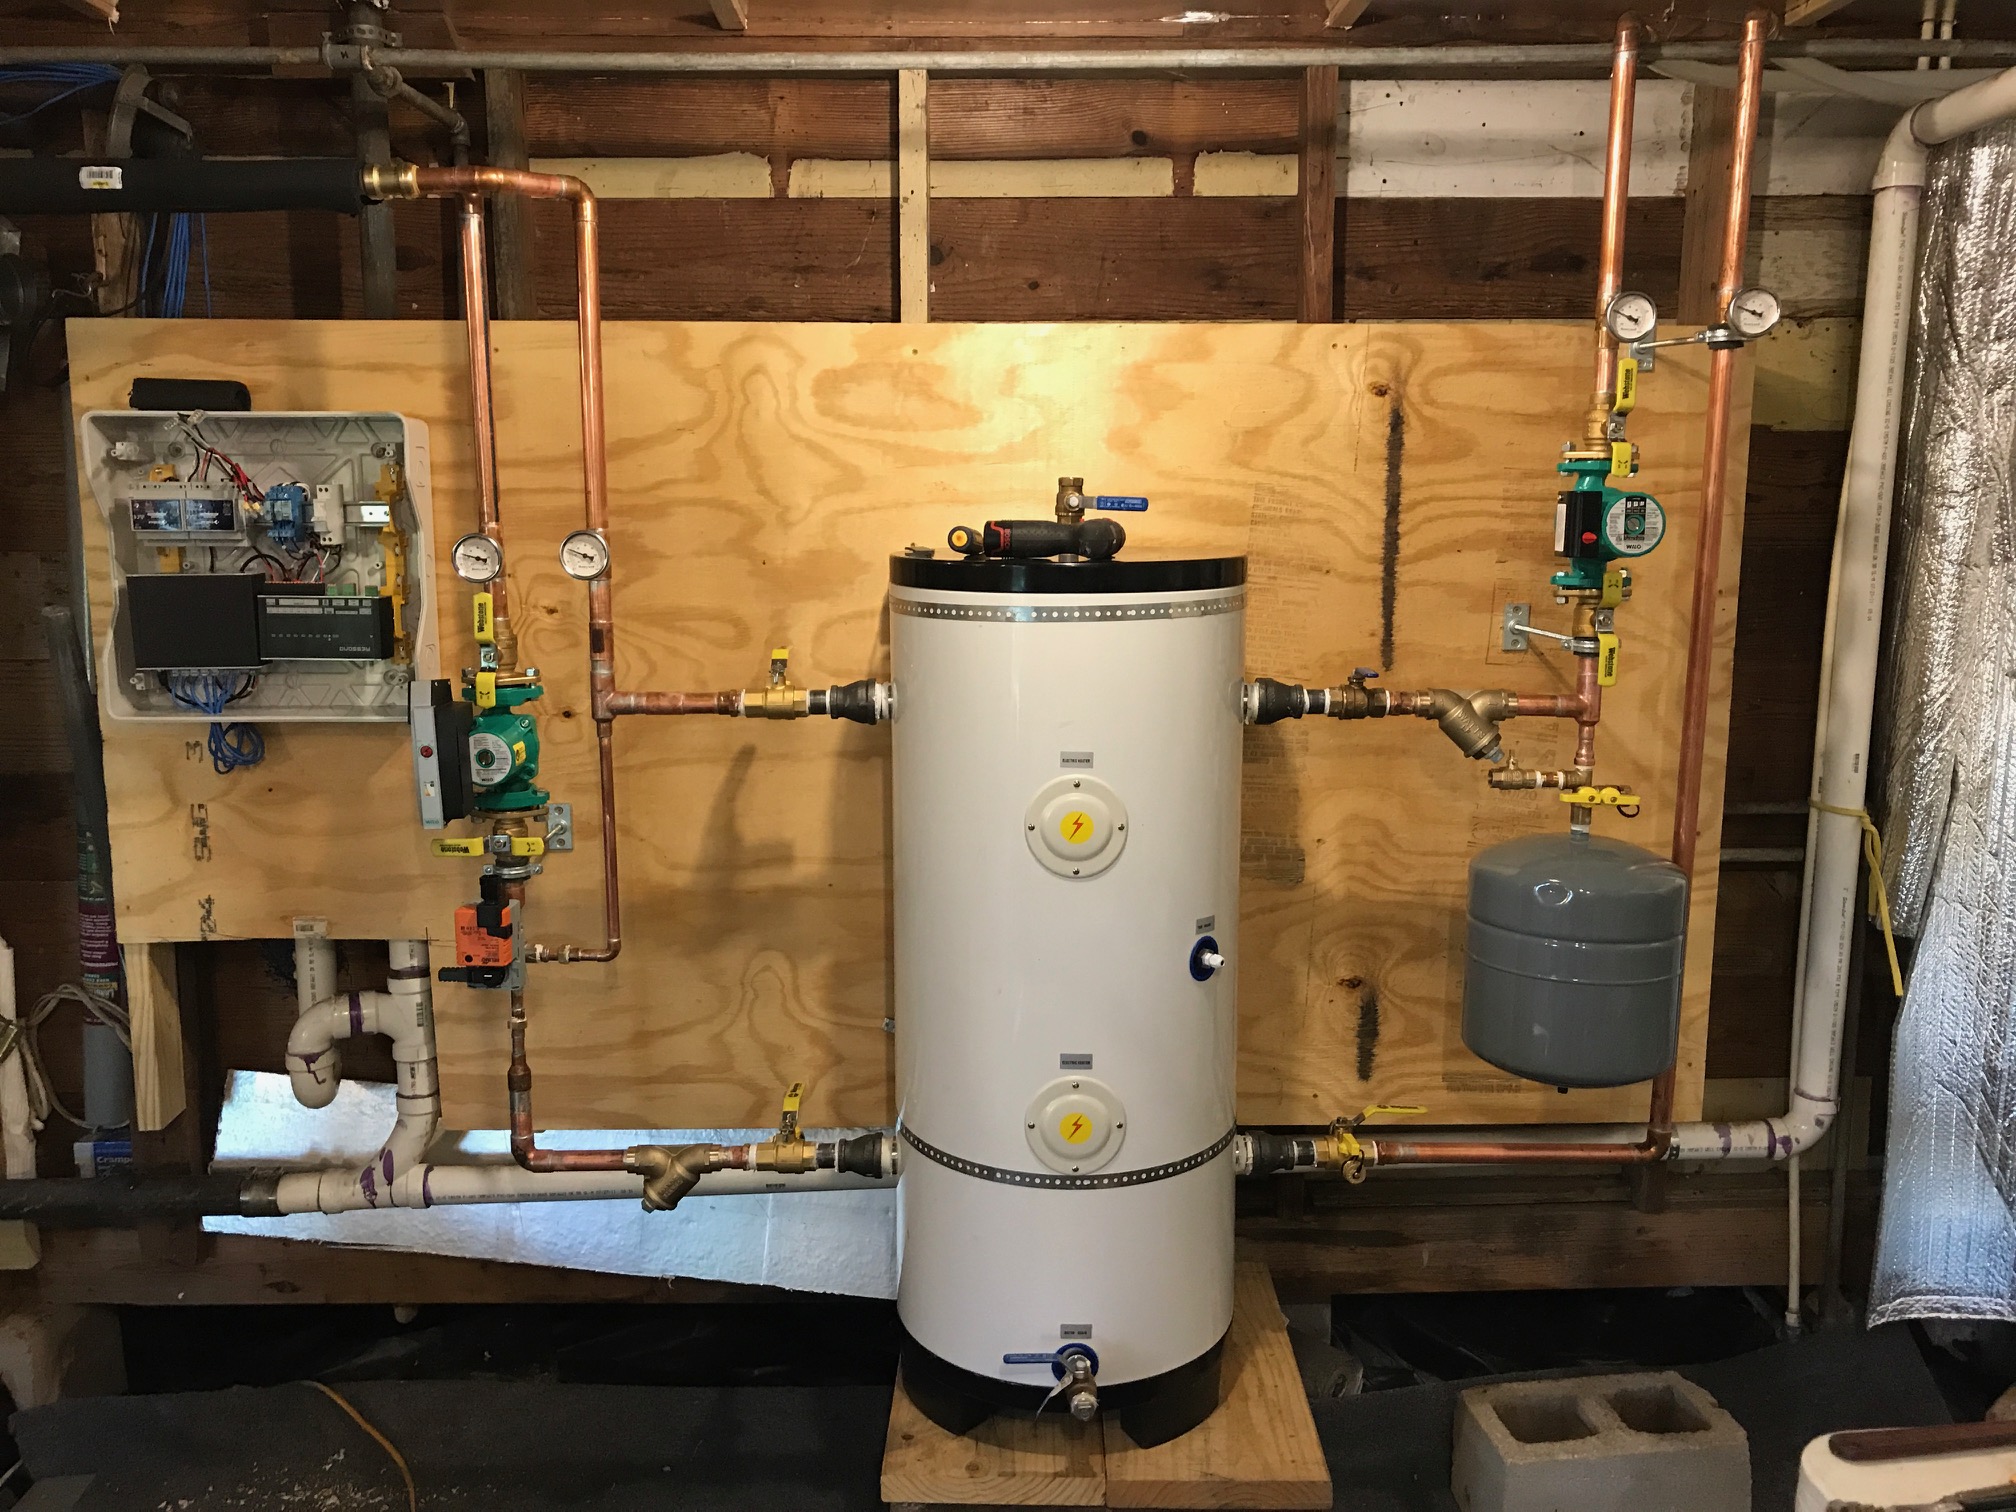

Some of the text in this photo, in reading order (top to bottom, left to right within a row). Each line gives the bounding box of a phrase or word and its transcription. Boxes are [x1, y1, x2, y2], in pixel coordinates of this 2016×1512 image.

[1622, 368, 1631, 400] Webstone
[477, 602, 486, 633] Webstone
[1607, 646, 1616, 677] Webstone
[440, 845, 470, 854] Webstone
[96, 1156, 132, 1164] Cramp
